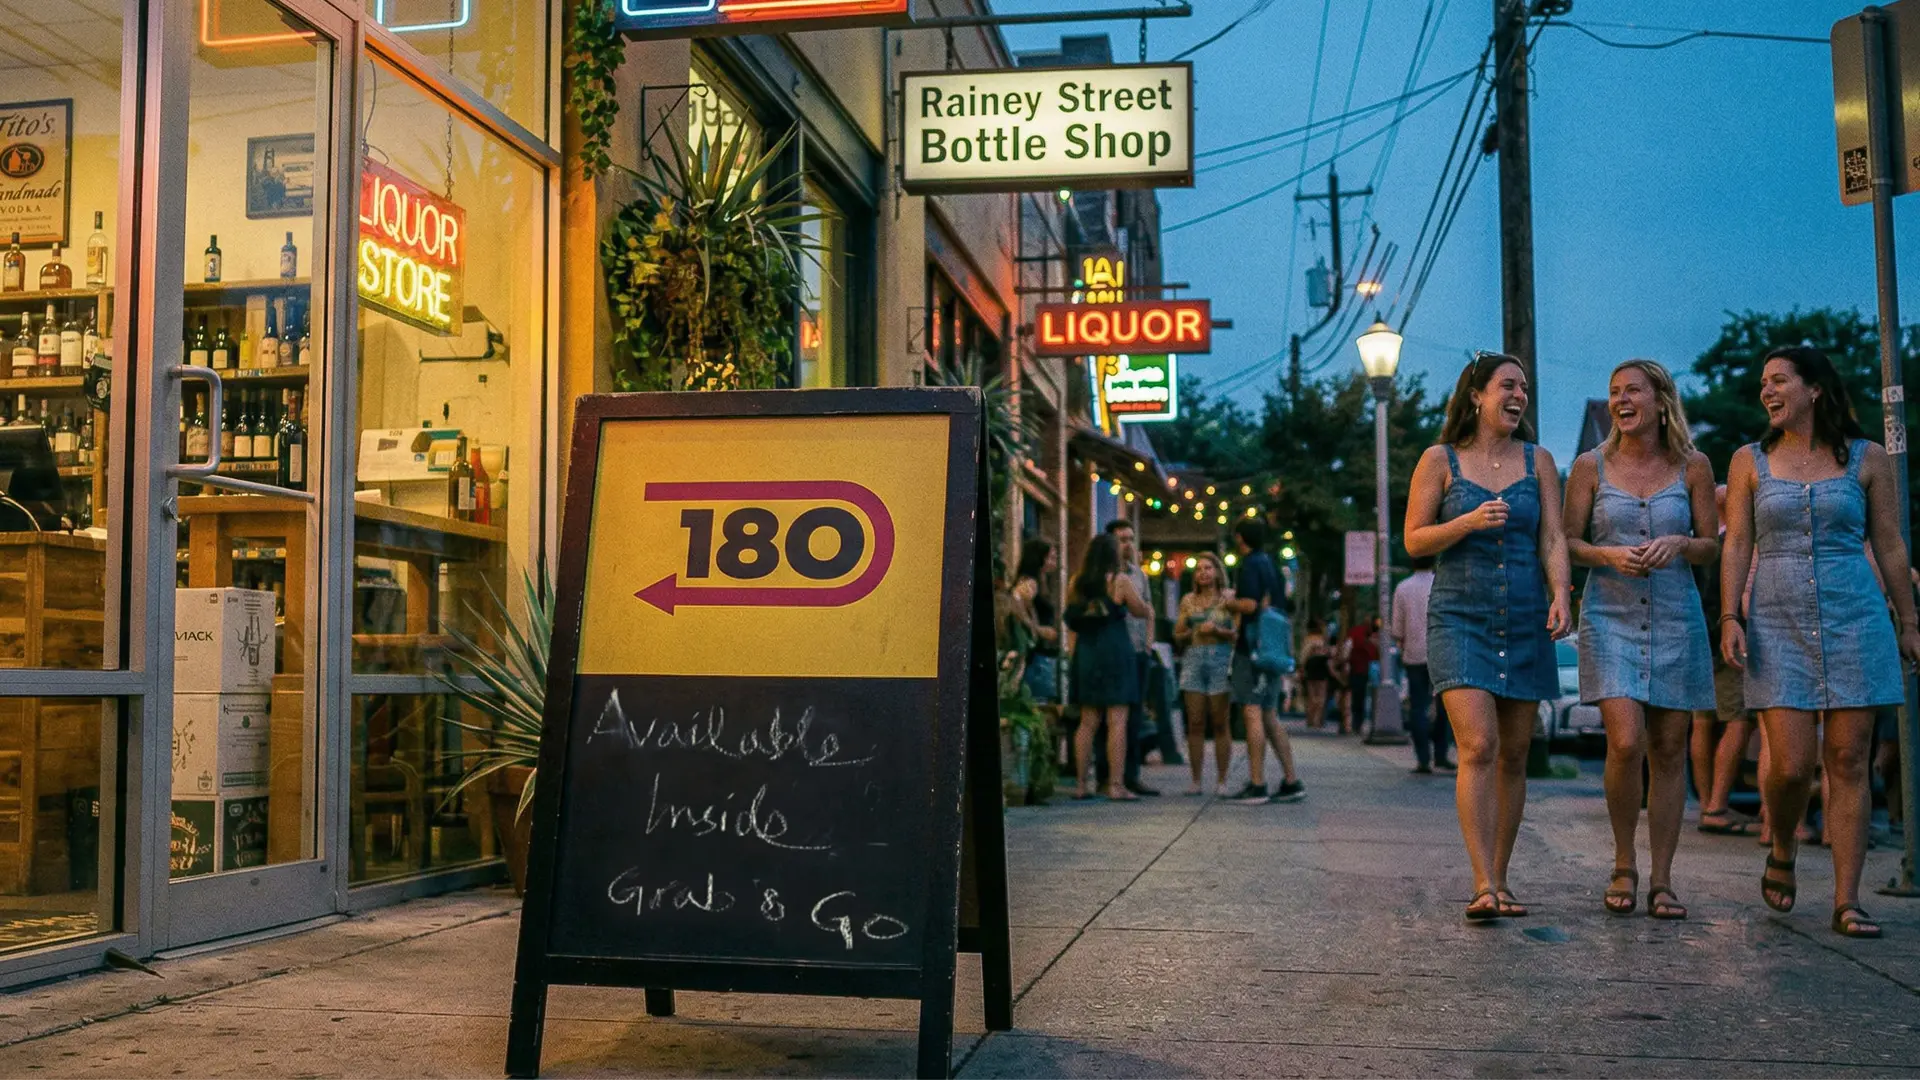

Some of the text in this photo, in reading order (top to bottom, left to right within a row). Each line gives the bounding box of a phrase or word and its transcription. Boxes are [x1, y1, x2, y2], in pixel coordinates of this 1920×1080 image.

[921, 79, 1173, 122] Rainey Street
[921, 123, 1172, 167] Bottle Shop
[0, 179, 62, 201] andmade
[0, 204, 42, 215] VODKA
[359, 238, 452, 324] STORE
[1042, 308, 1203, 346] LIQUOR
[680, 506, 865, 580] 180
[586, 688, 877, 767] Available
[645, 772, 832, 850] Inside
[608, 866, 736, 916] Grab
[811, 890, 910, 950] Go
